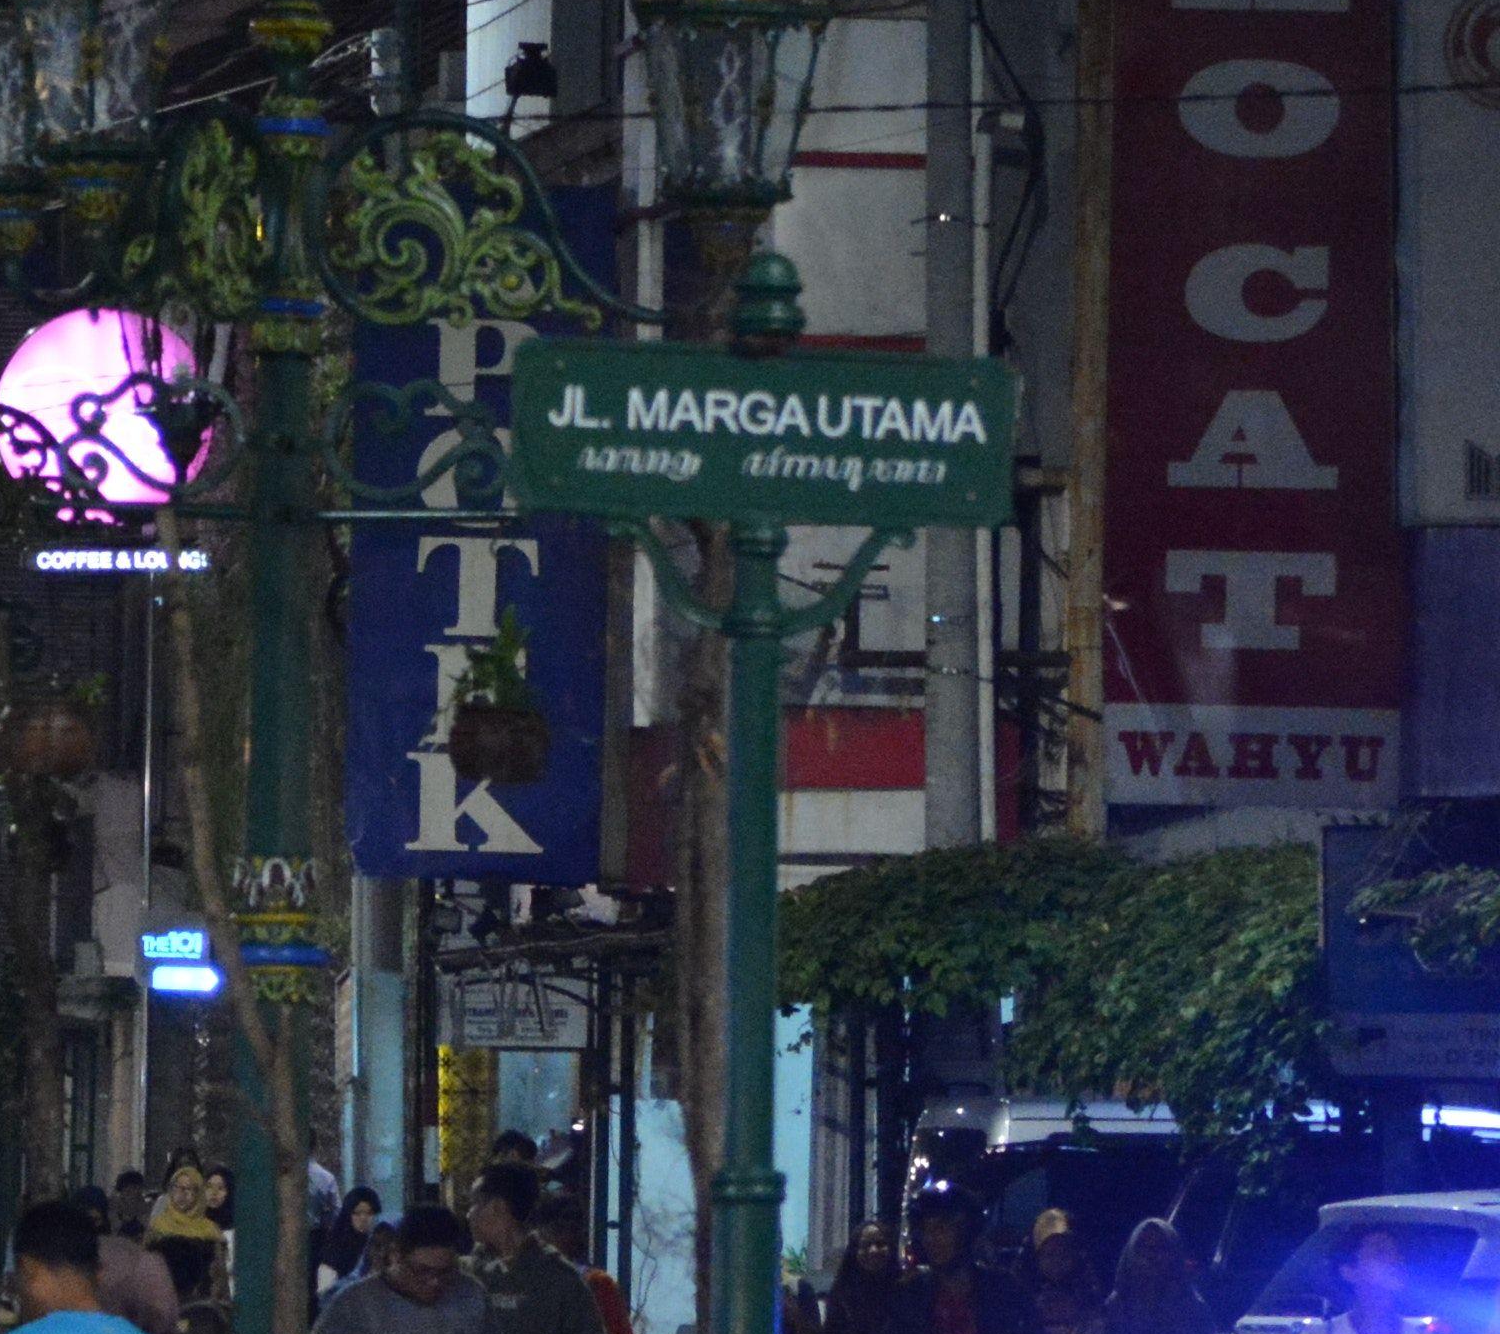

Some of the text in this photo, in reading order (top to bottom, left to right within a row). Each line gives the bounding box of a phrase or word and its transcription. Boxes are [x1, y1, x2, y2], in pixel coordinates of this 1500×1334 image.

[547, 384, 987, 446] JL. MARGA UTAMA
[1166, 244, 1340, 651] CAT
[36, 551, 112, 570] COFFEE
[115, 551, 132, 570] &
[1117, 729, 1386, 782] WAHYU
